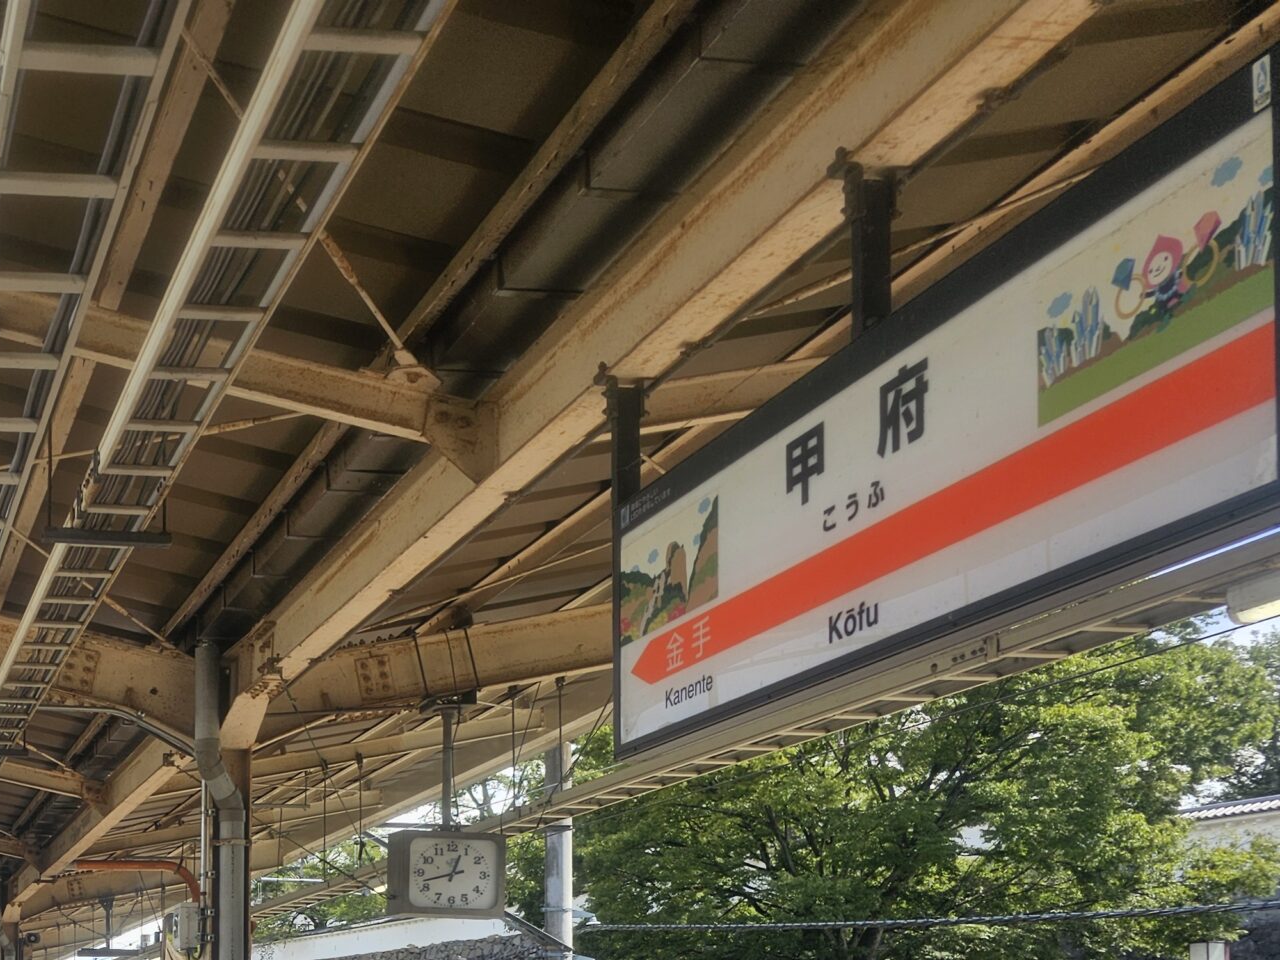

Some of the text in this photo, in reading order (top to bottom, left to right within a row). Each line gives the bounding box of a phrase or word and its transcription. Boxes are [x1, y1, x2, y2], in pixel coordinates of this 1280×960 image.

[786, 356, 928, 506] 甲府
[822, 480, 885, 532] こうふ
[827, 601, 880, 644] Kōfu
[665, 615, 711, 672] 金手
[665, 674, 713, 709] Kanente
[434, 847, 444, 856] 11
[447, 843, 458, 852] 12
[464, 847, 469, 856] 1
[422, 856, 434, 865] 10
[473, 856, 482, 865] 2
[416, 868, 425, 877] 9
[479, 871, 487, 880] 3
[422, 882, 430, 892] 8
[472, 885, 480, 894] 4
[434, 892, 443, 901] 7
[447, 895, 456, 904] 6
[460, 893, 468, 902] 5
